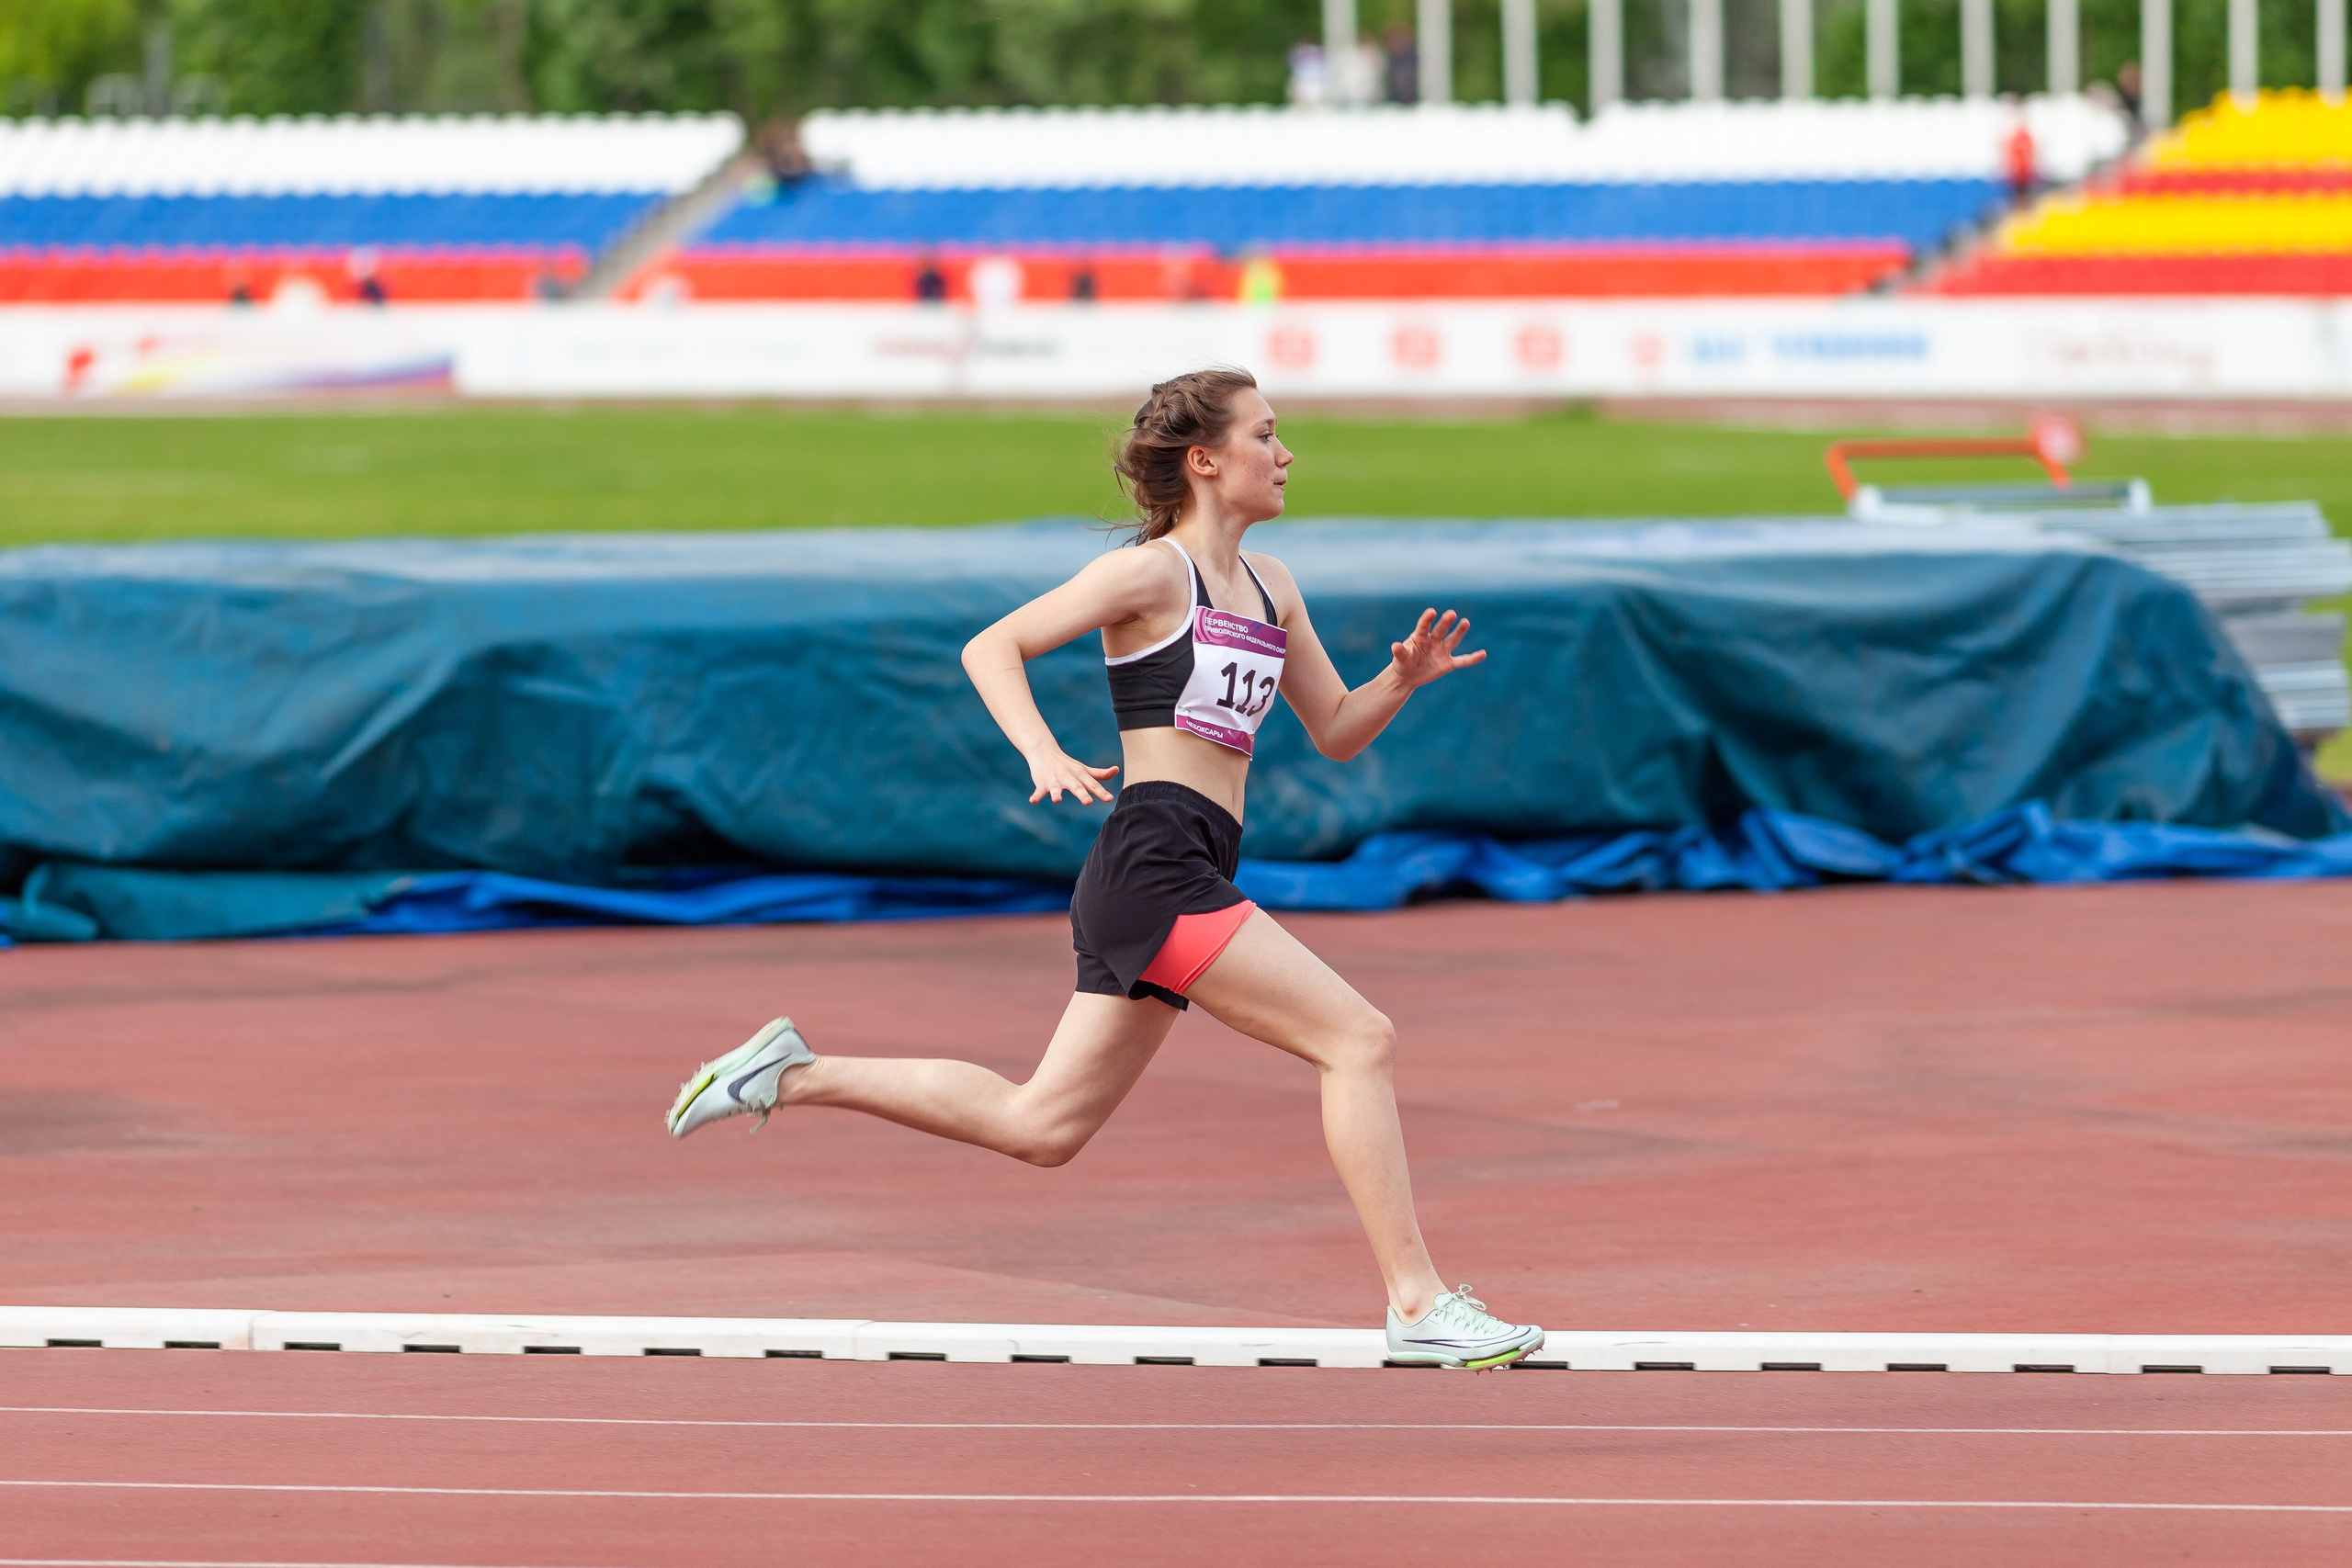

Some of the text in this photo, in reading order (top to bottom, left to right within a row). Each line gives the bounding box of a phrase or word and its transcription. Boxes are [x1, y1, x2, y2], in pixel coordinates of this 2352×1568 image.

[1204, 616, 1249, 634] ПЕРВЕНСТВО
[1275, 647, 1286, 655] ОКР
[1216, 661, 1275, 717] 113
[1185, 719, 1224, 739] ЧЕБОКСАРЫ
